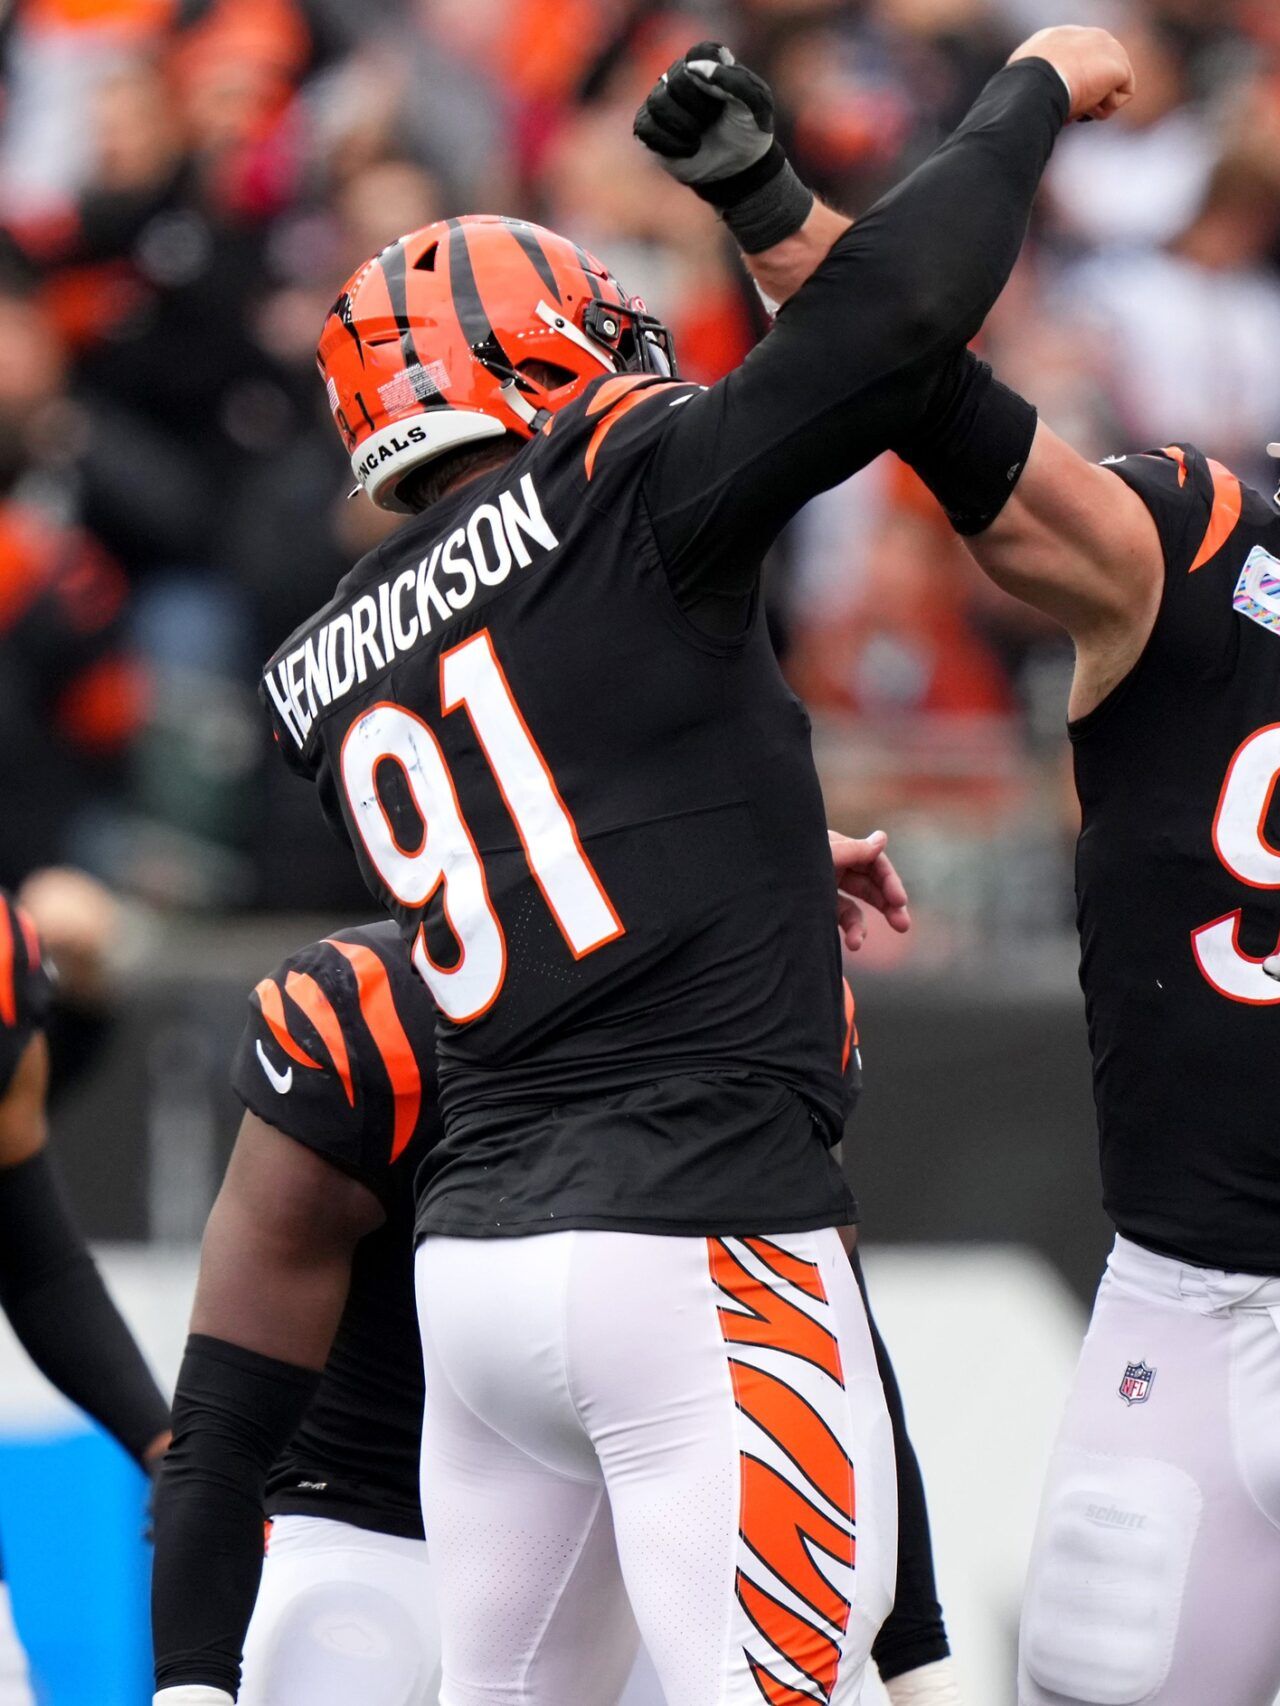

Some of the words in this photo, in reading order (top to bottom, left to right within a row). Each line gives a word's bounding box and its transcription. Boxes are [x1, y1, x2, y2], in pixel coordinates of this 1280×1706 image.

[265, 472, 559, 749] HENDRICKSON
[339, 627, 626, 1024] 91
[1121, 1377, 1146, 1397] NFL
